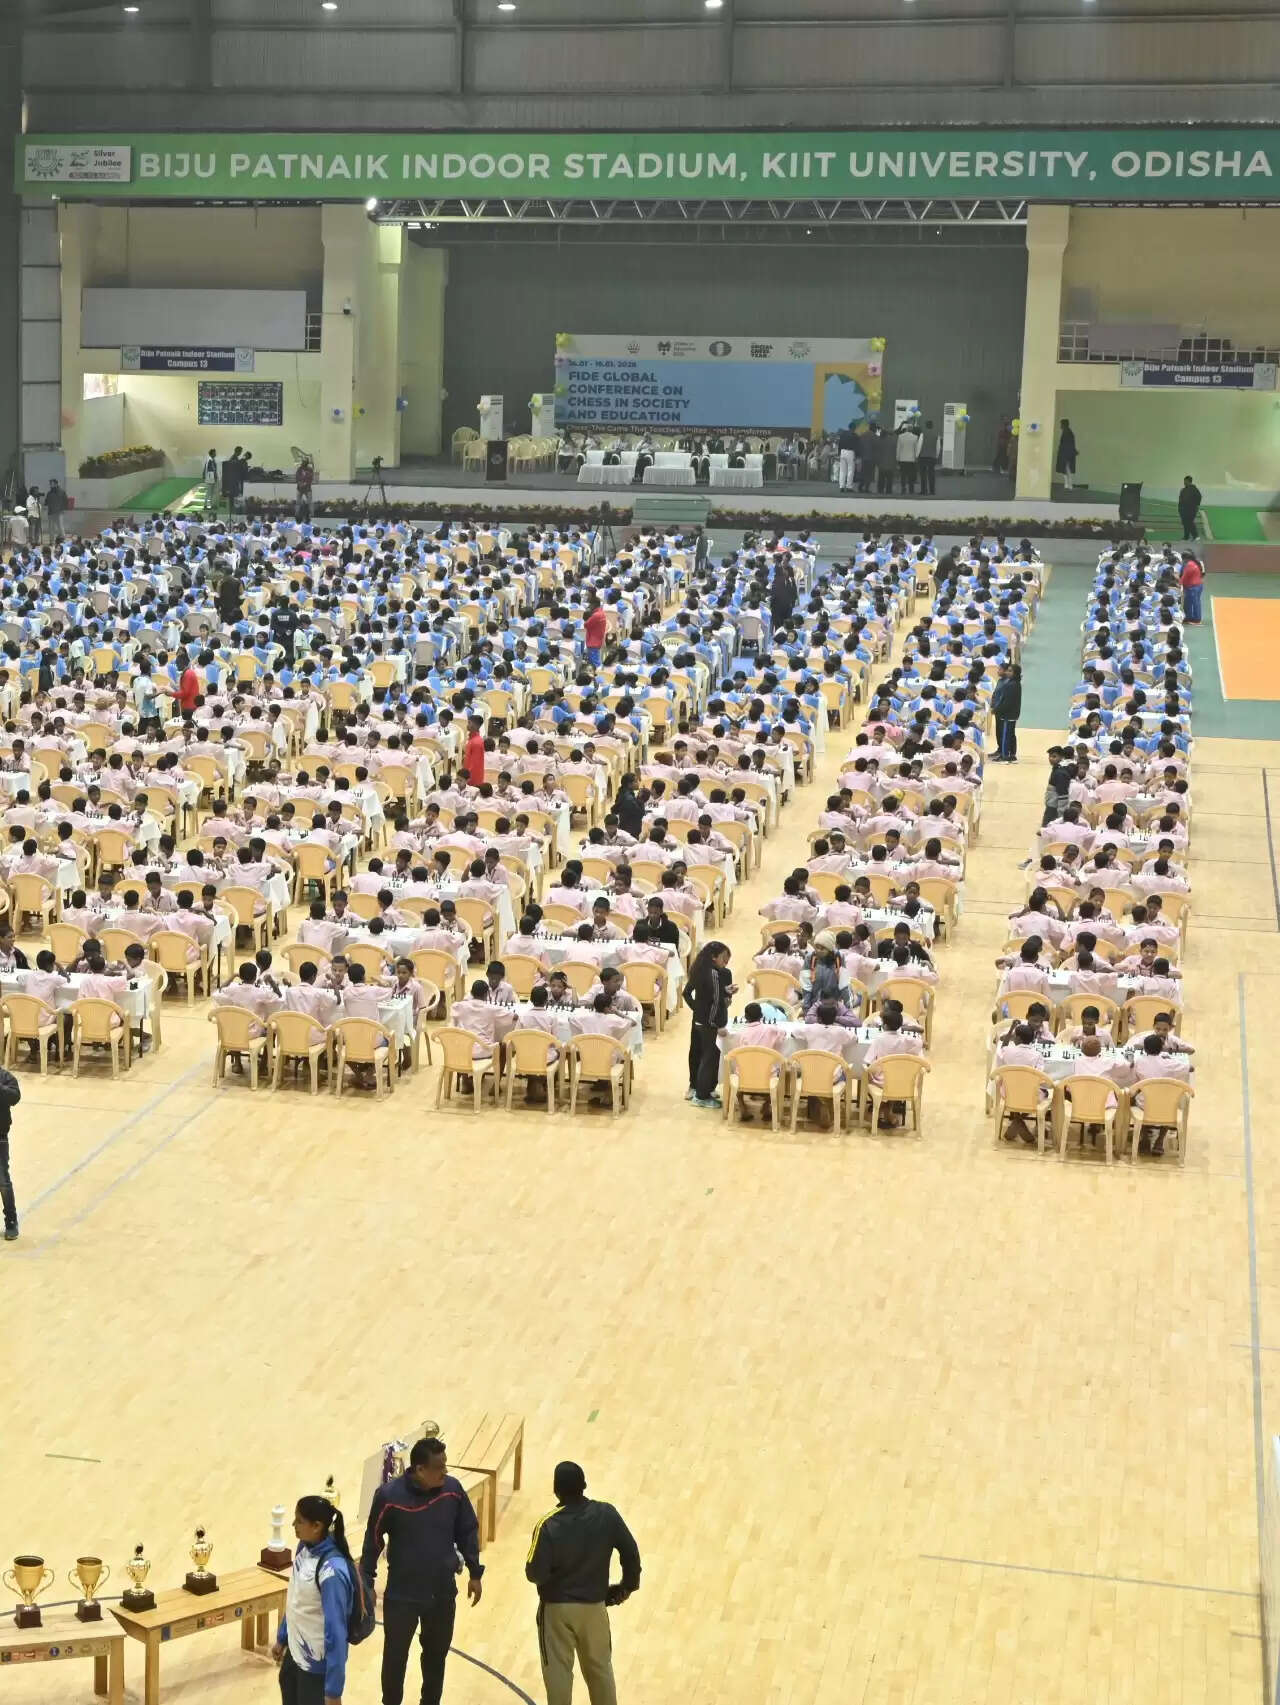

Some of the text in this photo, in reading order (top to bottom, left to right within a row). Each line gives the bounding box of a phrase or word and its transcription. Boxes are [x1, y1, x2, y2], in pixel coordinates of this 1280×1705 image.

[93, 159, 122, 167] Jubilee
[139, 150, 1272, 182] BIJU PATNAIK INDOOR STADIUM, KIIT UNIVERSITY, ODISHA
[167, 359, 198, 368] Campus
[1193, 364, 1219, 372] Indoor
[1220, 365, 1254, 373] Stadium
[569, 371, 658, 382] FIDE GLOBAL
[1174, 374, 1211, 384] Campus
[568, 384, 683, 396] CONFERENCE ON
[568, 397, 690, 408] CHESS IN SOCIETY
[567, 410, 681, 421] AND EDUCATION
